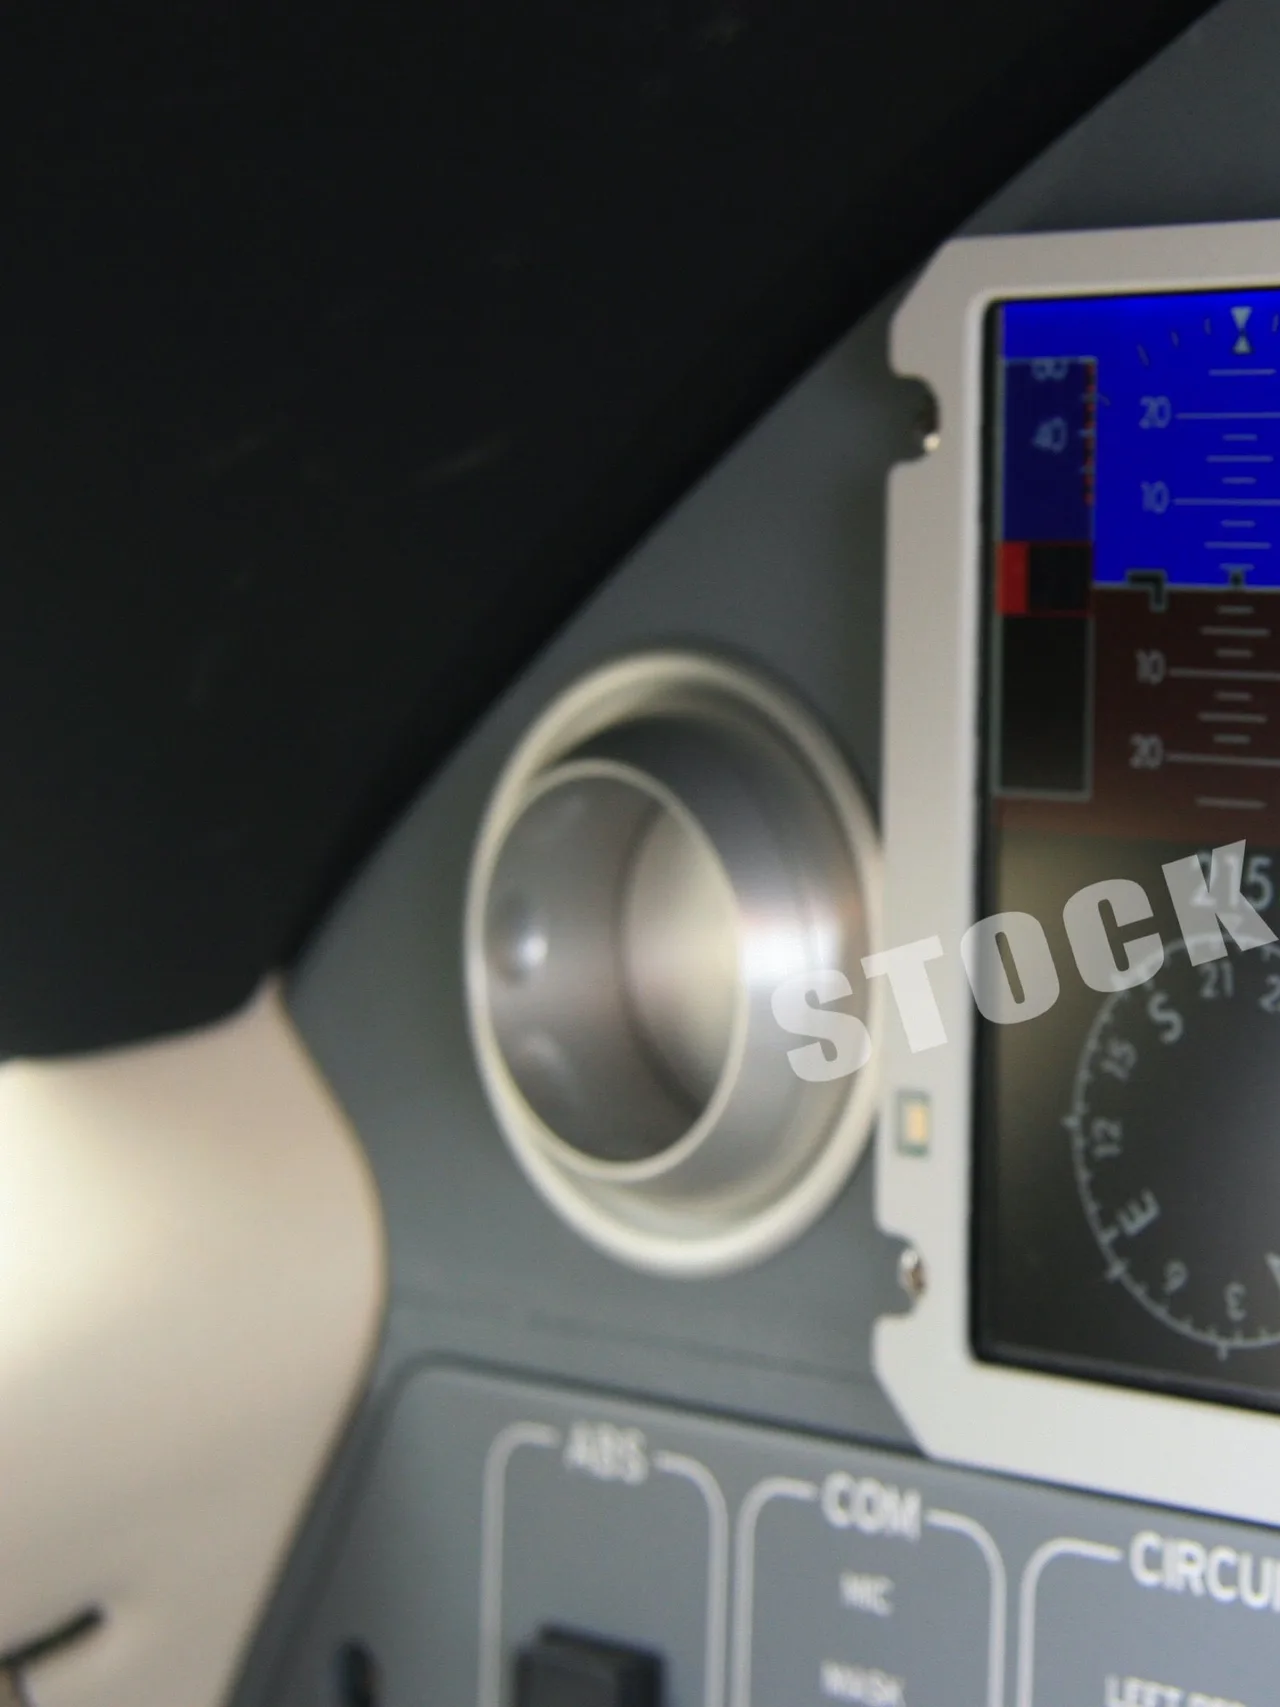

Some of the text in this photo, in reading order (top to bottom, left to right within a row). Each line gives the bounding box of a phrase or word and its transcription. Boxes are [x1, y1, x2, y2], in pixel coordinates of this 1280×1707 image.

[1139, 396, 1171, 429] 20
[1032, 417, 1068, 453] 40
[1140, 481, 1171, 514] 10
[1135, 650, 1166, 684] 10
[1130, 735, 1163, 769] 20
[1148, 993, 1183, 1044] S
[564, 1421, 649, 1485] ABS
[821, 1471, 922, 1542] COM
